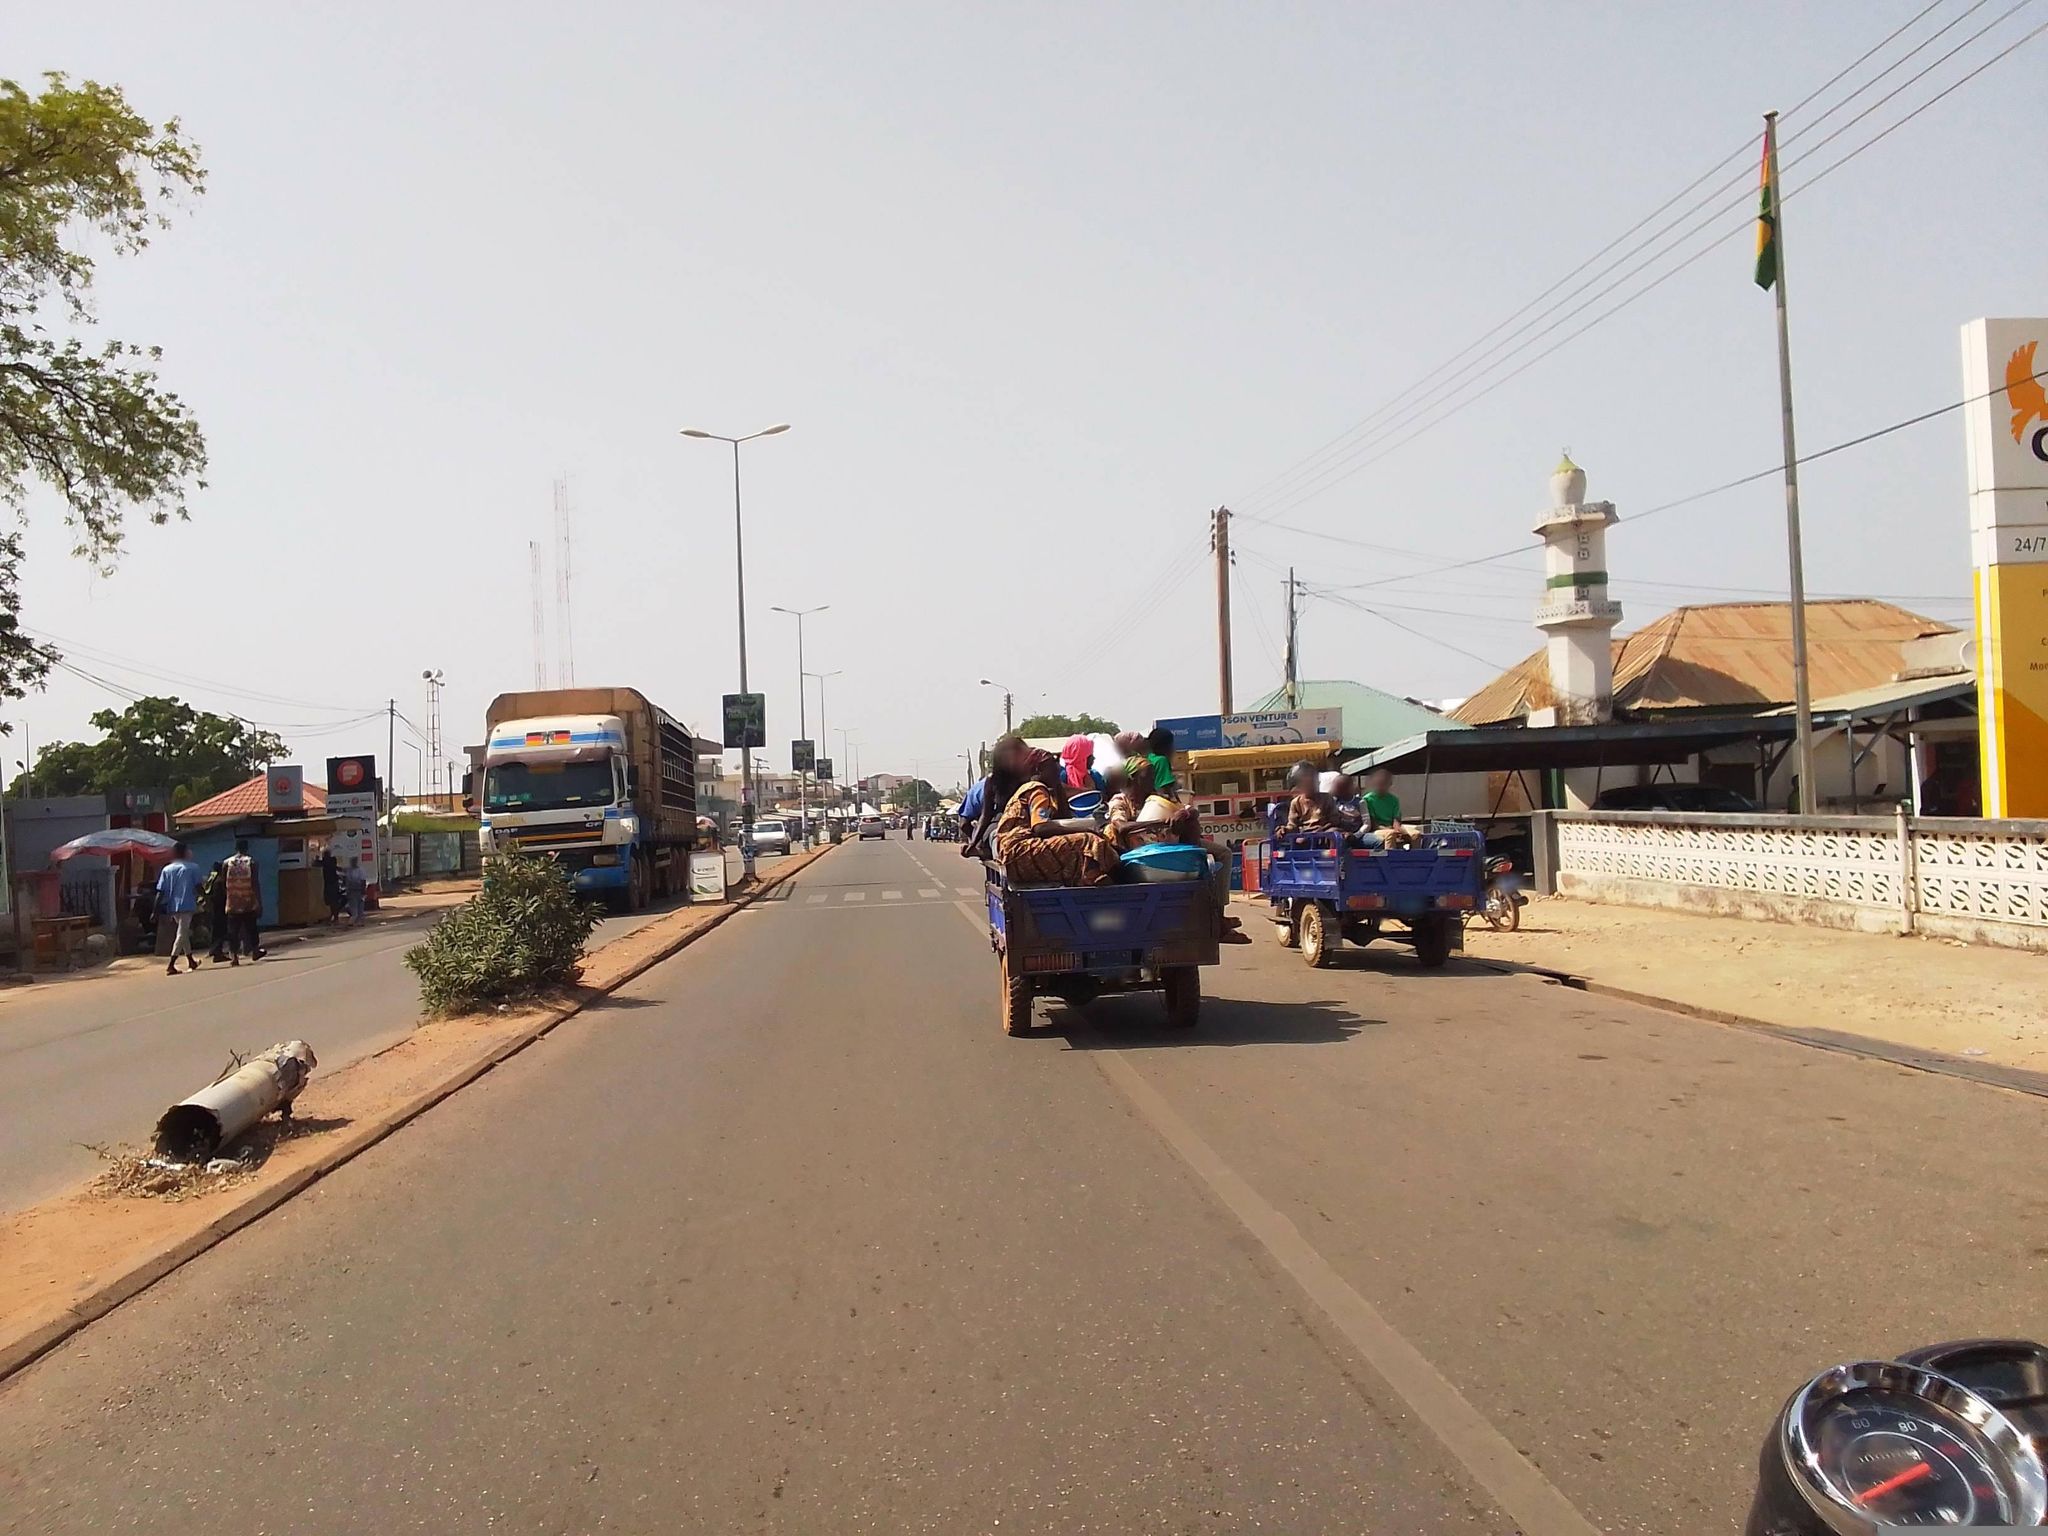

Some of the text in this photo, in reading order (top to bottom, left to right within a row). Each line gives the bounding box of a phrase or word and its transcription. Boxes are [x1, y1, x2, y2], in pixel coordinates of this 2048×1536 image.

[2014, 537, 2047, 553] 24/7
[1249, 712, 1299, 722] VENTURES
[1898, 1421, 1918, 1432] 80
